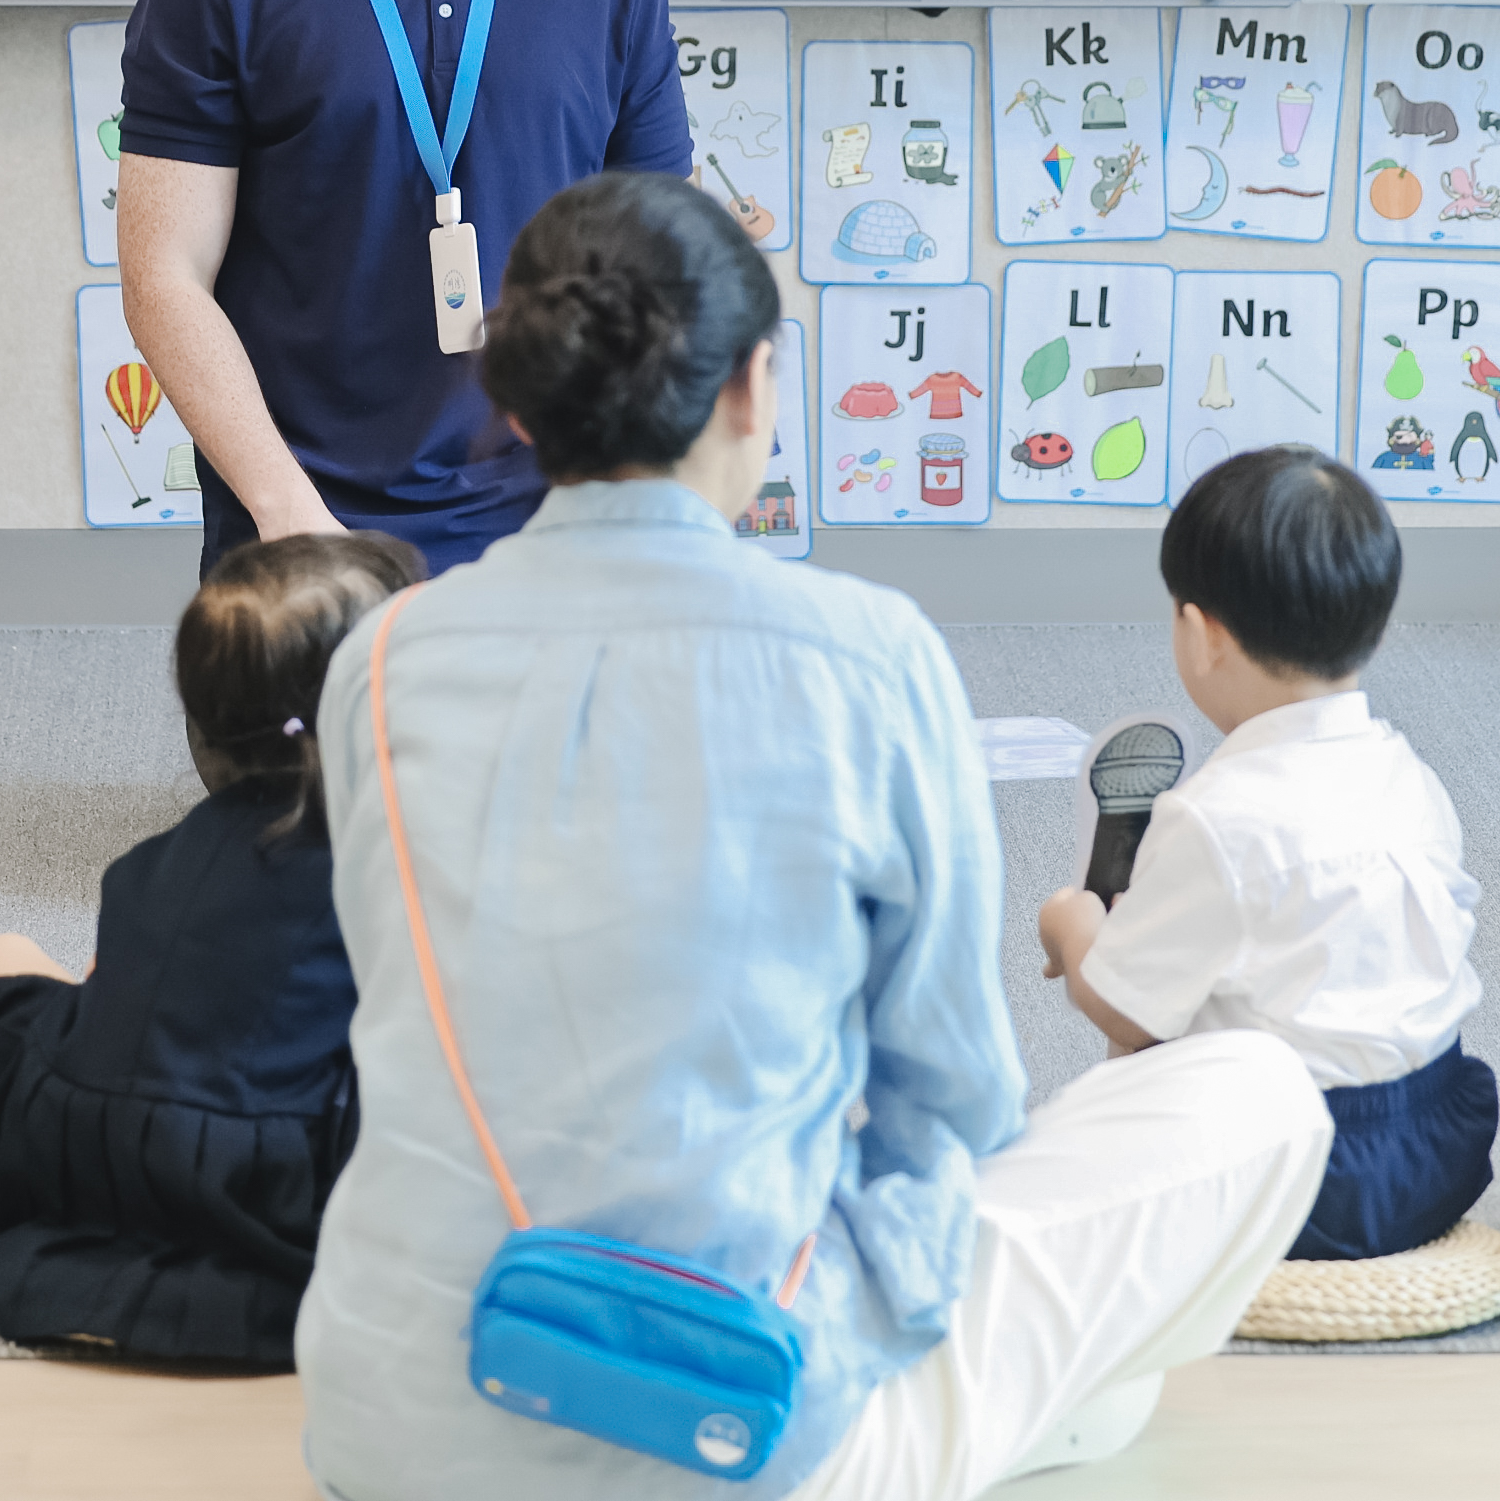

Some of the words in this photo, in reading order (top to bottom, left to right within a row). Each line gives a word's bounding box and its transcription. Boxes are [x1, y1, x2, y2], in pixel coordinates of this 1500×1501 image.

[677, 37, 737, 89] Gg
[1043, 22, 1110, 66] Kk
[1216, 18, 1308, 64] Mm
[1415, 30, 1484, 72] Oo
[870, 66, 908, 108] Ii
[1069, 287, 1112, 329] Ll
[1221, 300, 1292, 338] Nn
[1417, 288, 1480, 340] Pp
[884, 308, 926, 362] Jj
